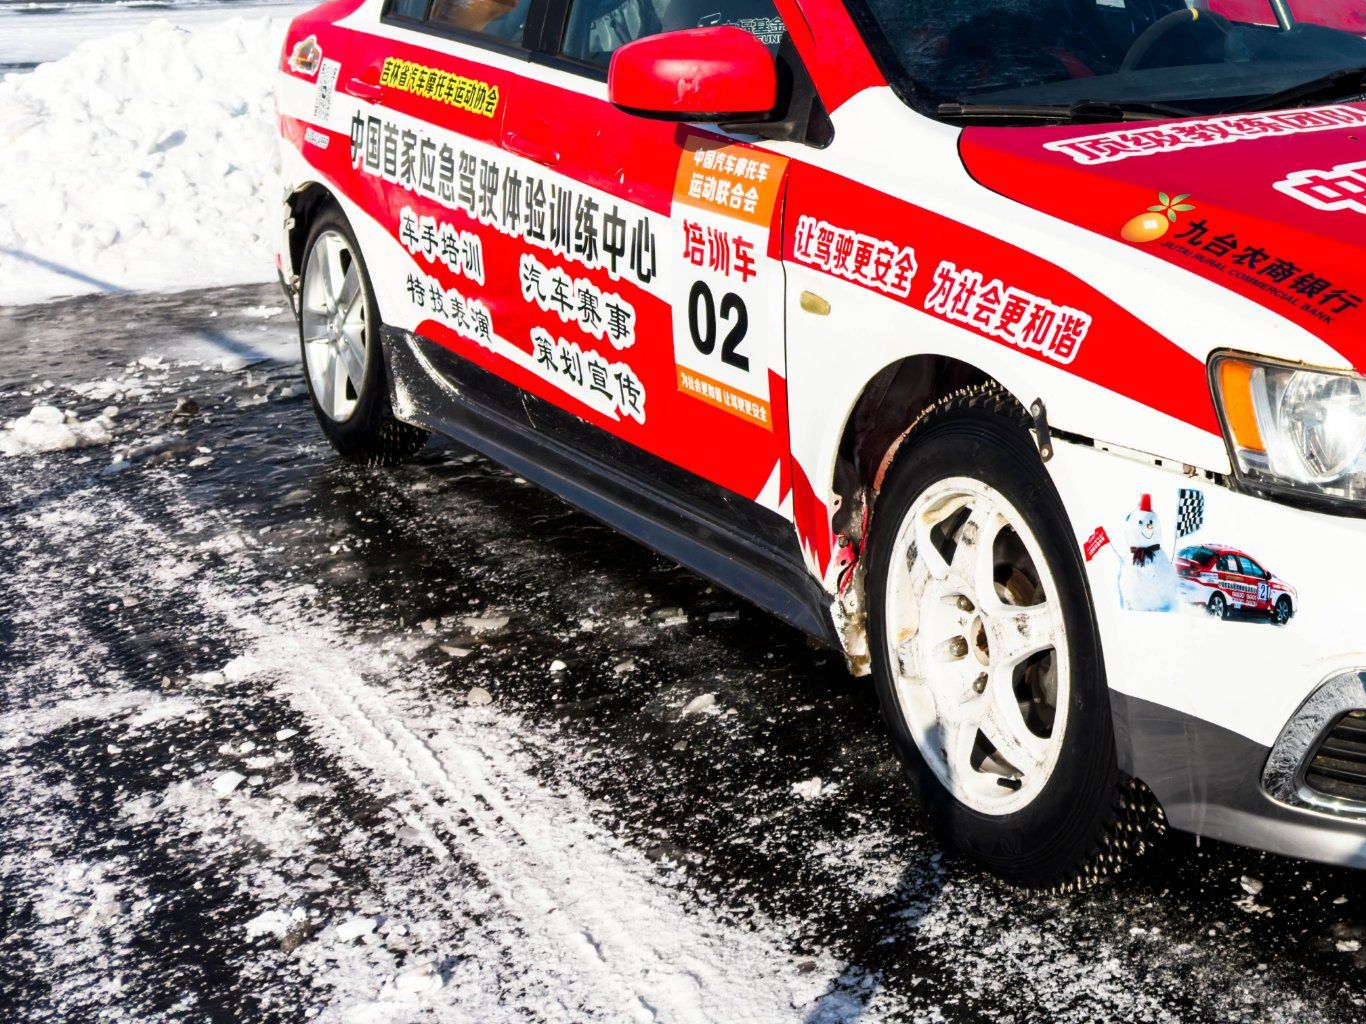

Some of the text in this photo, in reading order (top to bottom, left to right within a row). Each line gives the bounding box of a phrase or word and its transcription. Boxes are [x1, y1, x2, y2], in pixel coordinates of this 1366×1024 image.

[381, 60, 498, 114] 吉林省汽车摩托车运动协会
[349, 108, 658, 284] 中国首家应急驾驶体验训练中心
[687, 172, 759, 213] 运动联合会
[693, 147, 771, 183] 中国汽车摩托车
[402, 215, 482, 278] 车手培训
[683, 218, 757, 283] 培训车
[1160, 240, 1333, 325] JIUTAI RURAL COMMERCIAL BANK
[1173, 218, 1363, 314] 九台农商银行
[406, 271, 493, 344] 特技表演
[522, 262, 632, 341] 汽车赛事
[688, 280, 750, 373] 02
[796, 219, 1087, 358] 让驾驶更安全 为社会更和谐
[534, 334, 642, 415] 策划宣传
[1260, 584, 1270, 600] 21
